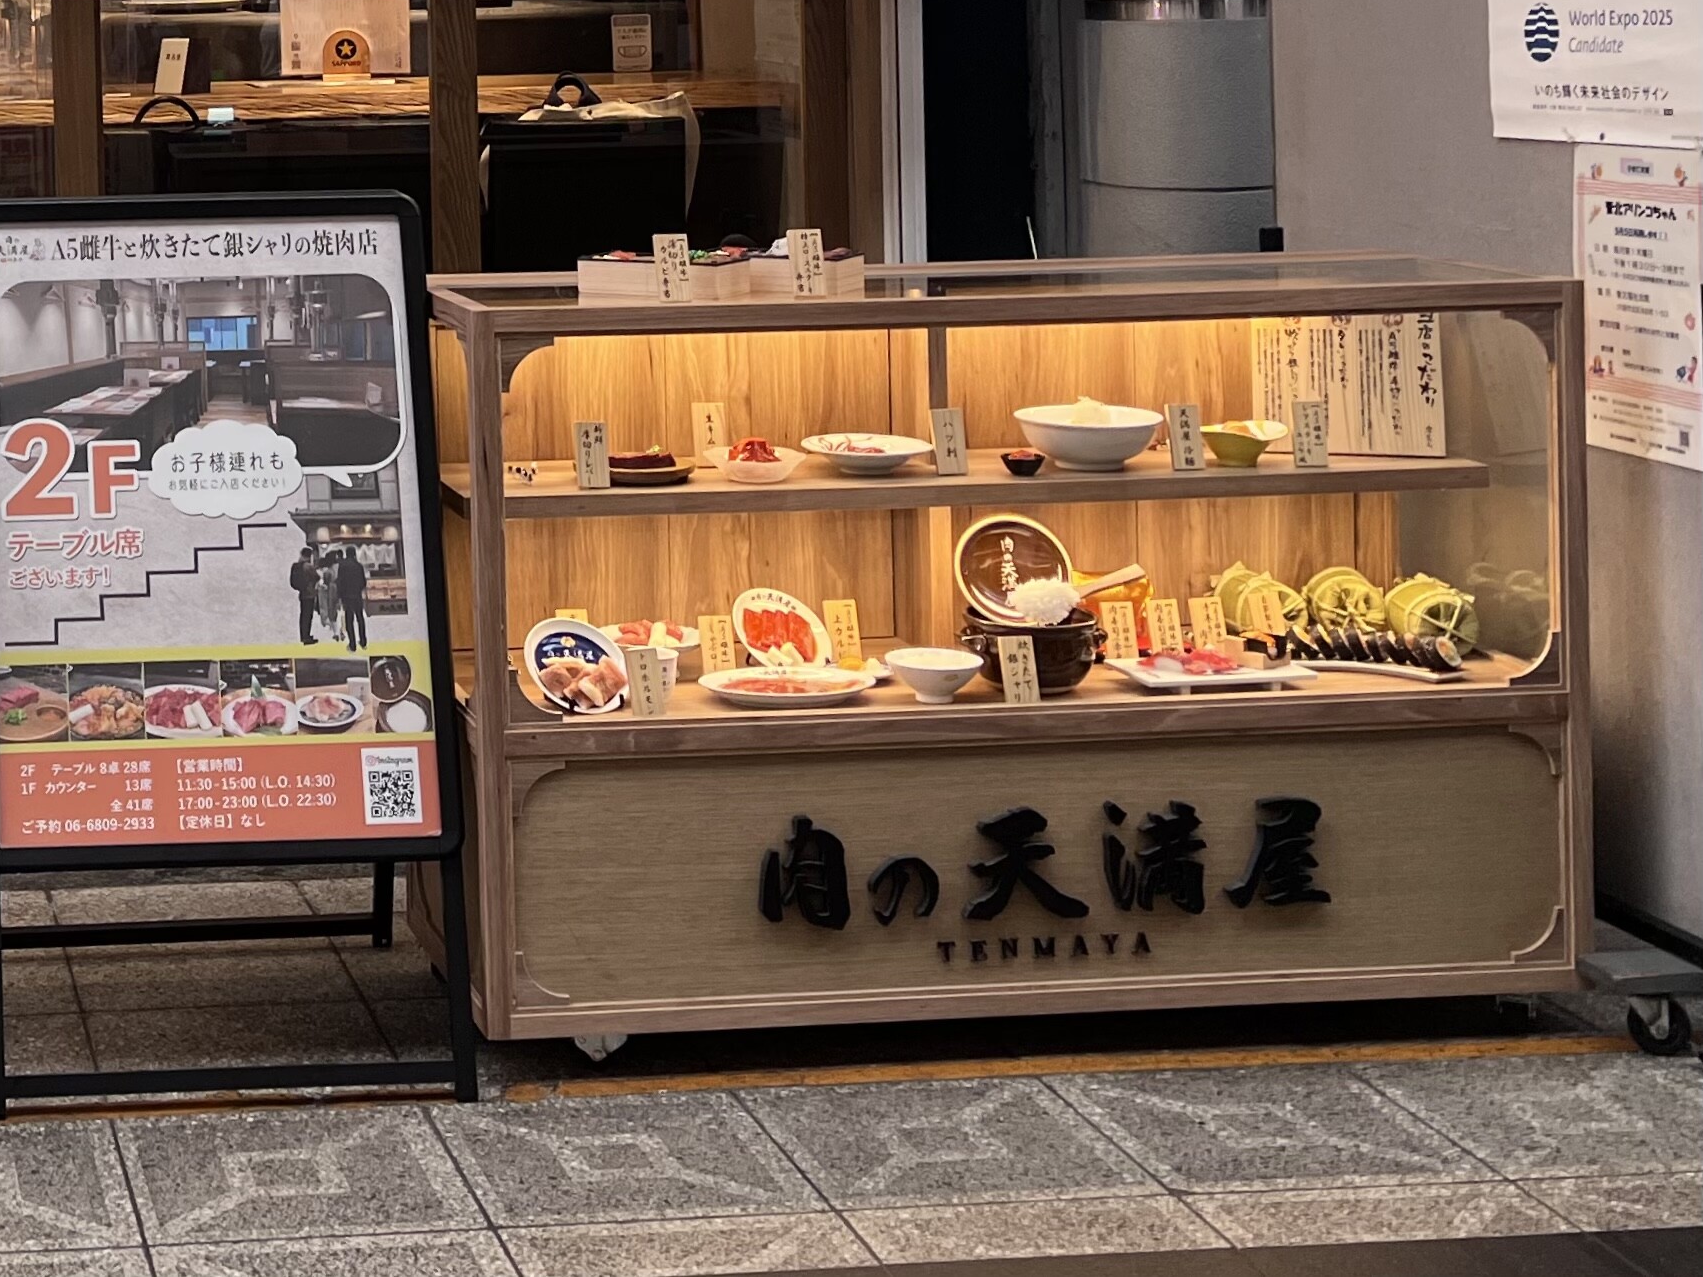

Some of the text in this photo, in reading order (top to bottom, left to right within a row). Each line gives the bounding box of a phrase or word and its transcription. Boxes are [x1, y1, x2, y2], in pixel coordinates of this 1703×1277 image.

[1568, 9, 1673, 31] World Expo 2025
[1568, 36, 1624, 53] Candidate
[50, 230, 379, 261] A5雌牛と炊きたて銀シャリの焼肉店
[2, 419, 140, 520] 2F
[170, 450, 285, 474] お子様連れも
[7, 527, 144, 561] テーブル席
[8, 566, 113, 590] ございます!
[20, 759, 152, 778] 2F テーブル 8卓 28席
[176, 756, 244, 774] 【営業時間】
[20, 778, 153, 796] 1F カウンター 13席
[177, 776, 257, 792] 11:30-15:00
[125, 797, 153, 812] 41席
[178, 795, 258, 810] 17:00-23:00
[21, 815, 155, 835] ご予約 06-6809-2933
[757, 796, 1331, 930] 肉の天満屋
[937, 931, 1152, 964] TENMAYA
